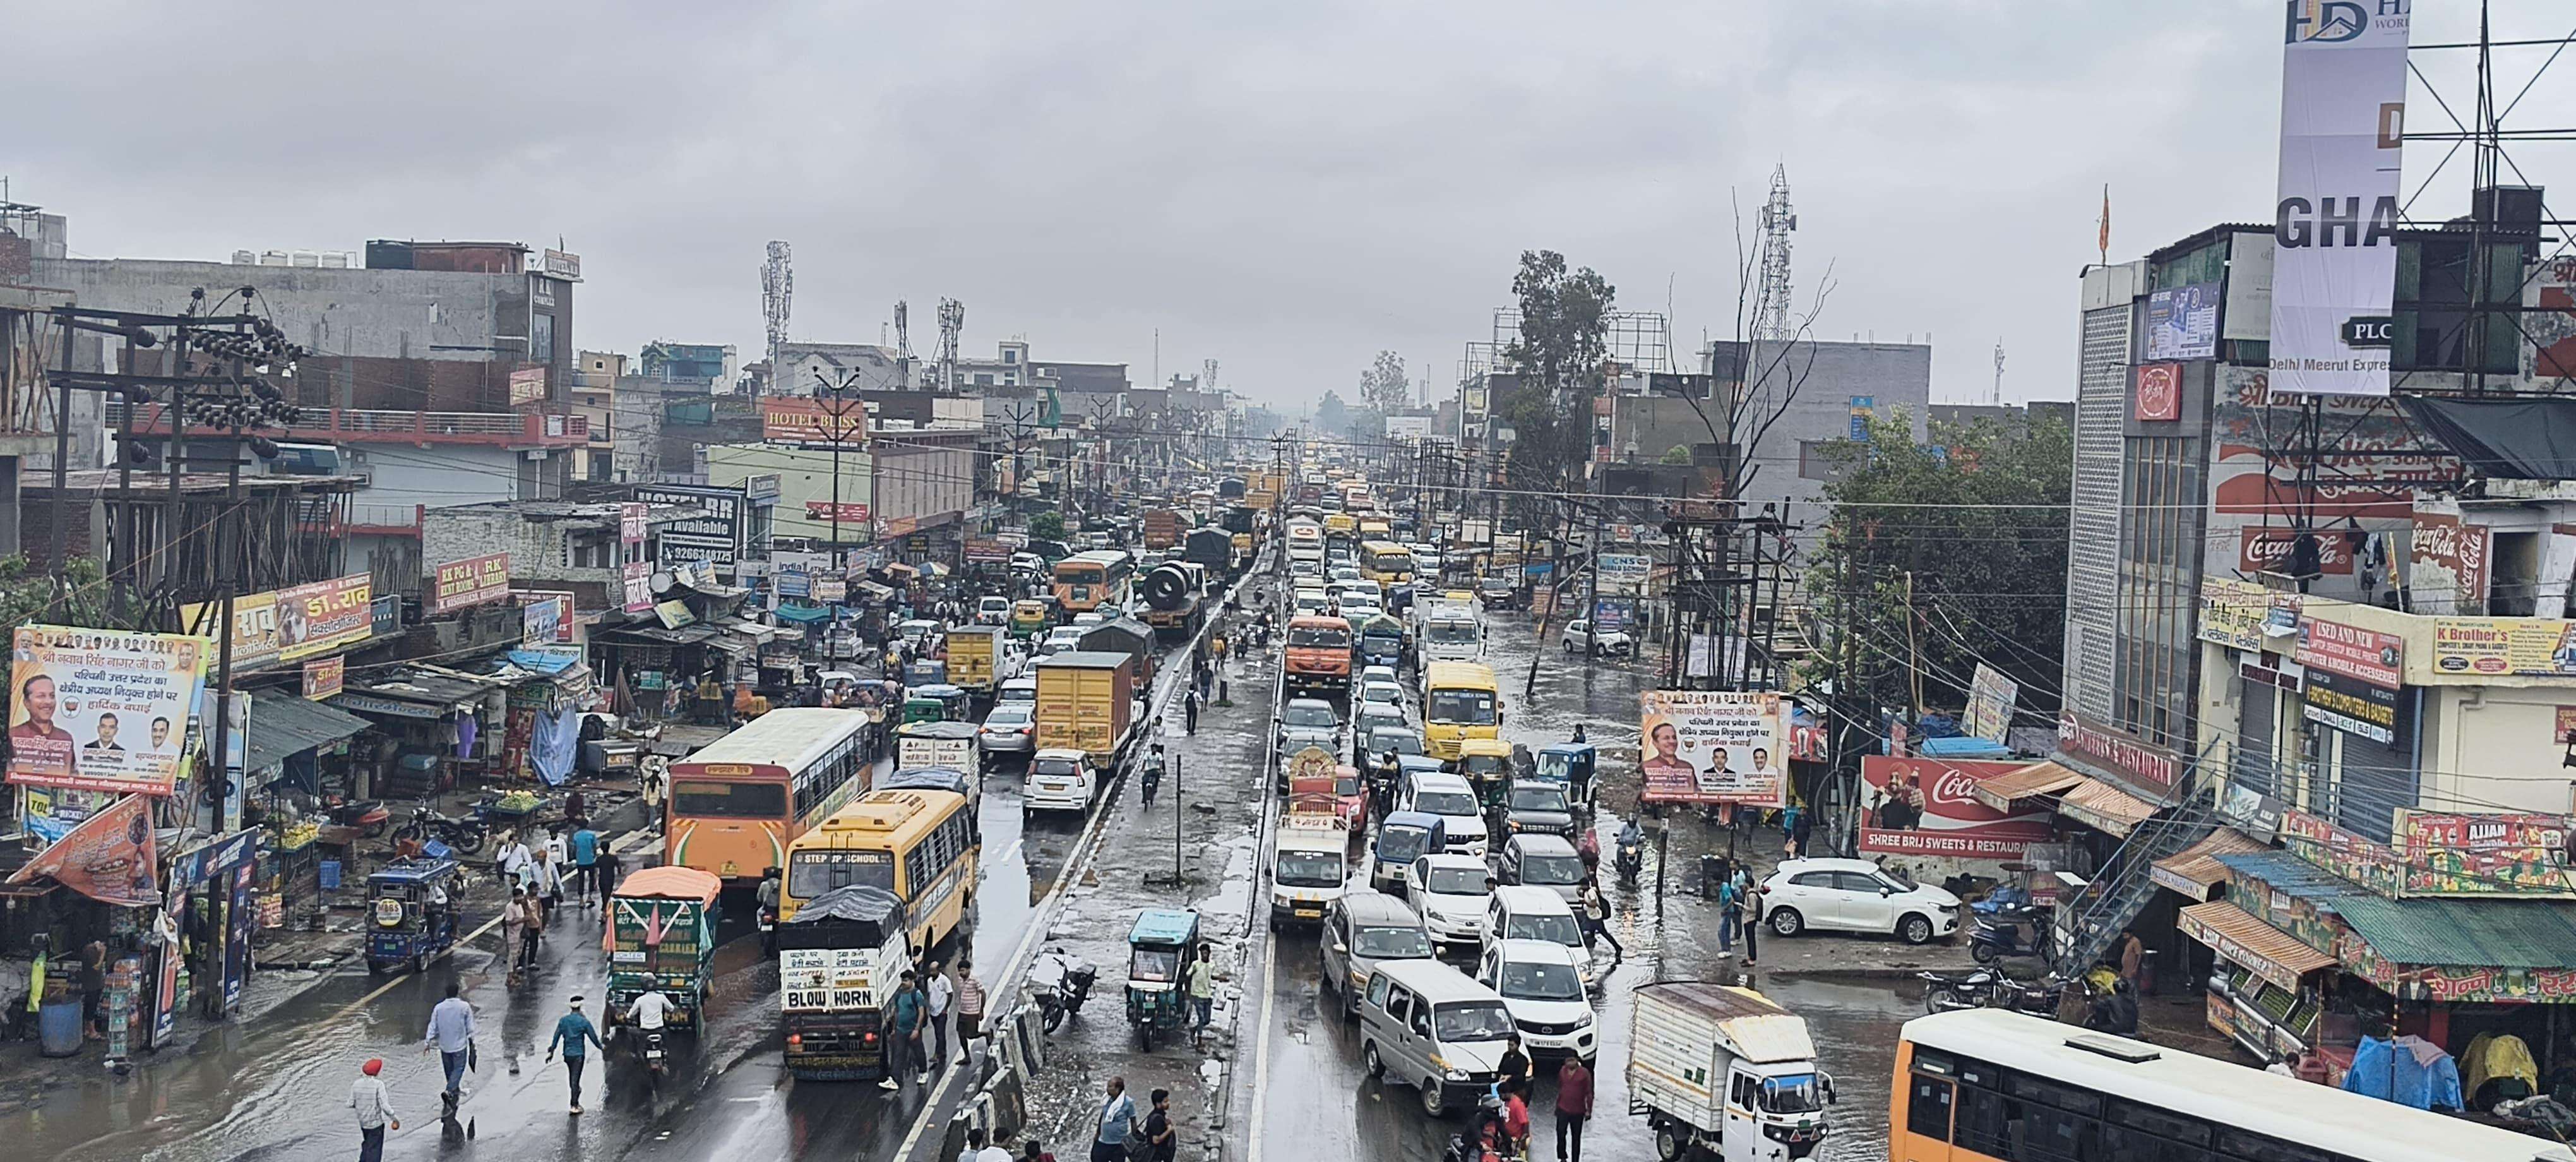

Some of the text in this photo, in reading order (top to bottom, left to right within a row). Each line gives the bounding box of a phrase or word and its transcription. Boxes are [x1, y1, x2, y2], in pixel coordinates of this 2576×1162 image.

[2275, 196, 2399, 248] GHA
[2269, 359, 2299, 371] Delhi
[2305, 359, 2348, 371] Meerut
[769, 412, 857, 428] HOTEL BLISS
[675, 520, 729, 534] Available
[485, 559, 501, 573] RK
[2317, 622, 2374, 649] USED AND NEW
[2438, 628, 2508, 642] K Brother's
[42, 652, 55, 663] श्री
[86, 653, 105, 667] सिंह
[107, 657, 134, 669] नागर
[136, 657, 148, 670] जी
[151, 657, 165, 671] को
[130, 672, 152, 685] प्रदेश
[154, 675, 167, 685] का
[85, 686, 112, 696] अध्यक्ष
[115, 686, 145, 702] नियुक्त
[146, 688, 164, 700] होने
[166, 692, 178, 701] पर
[88, 698, 120, 710] हार्दिक
[2120, 743, 2173, 786] RESTAURAN
[1868, 834, 1900, 846] SHREE
[1902, 836, 1923, 848] BRIJ
[1926, 837, 1965, 850] SWEETS
[1967, 840, 1974, 850] &
[805, 854, 827, 863] STEP
[2434, 969, 2493, 998] गन्ने
[789, 990, 871, 1007] BLOW HORN
